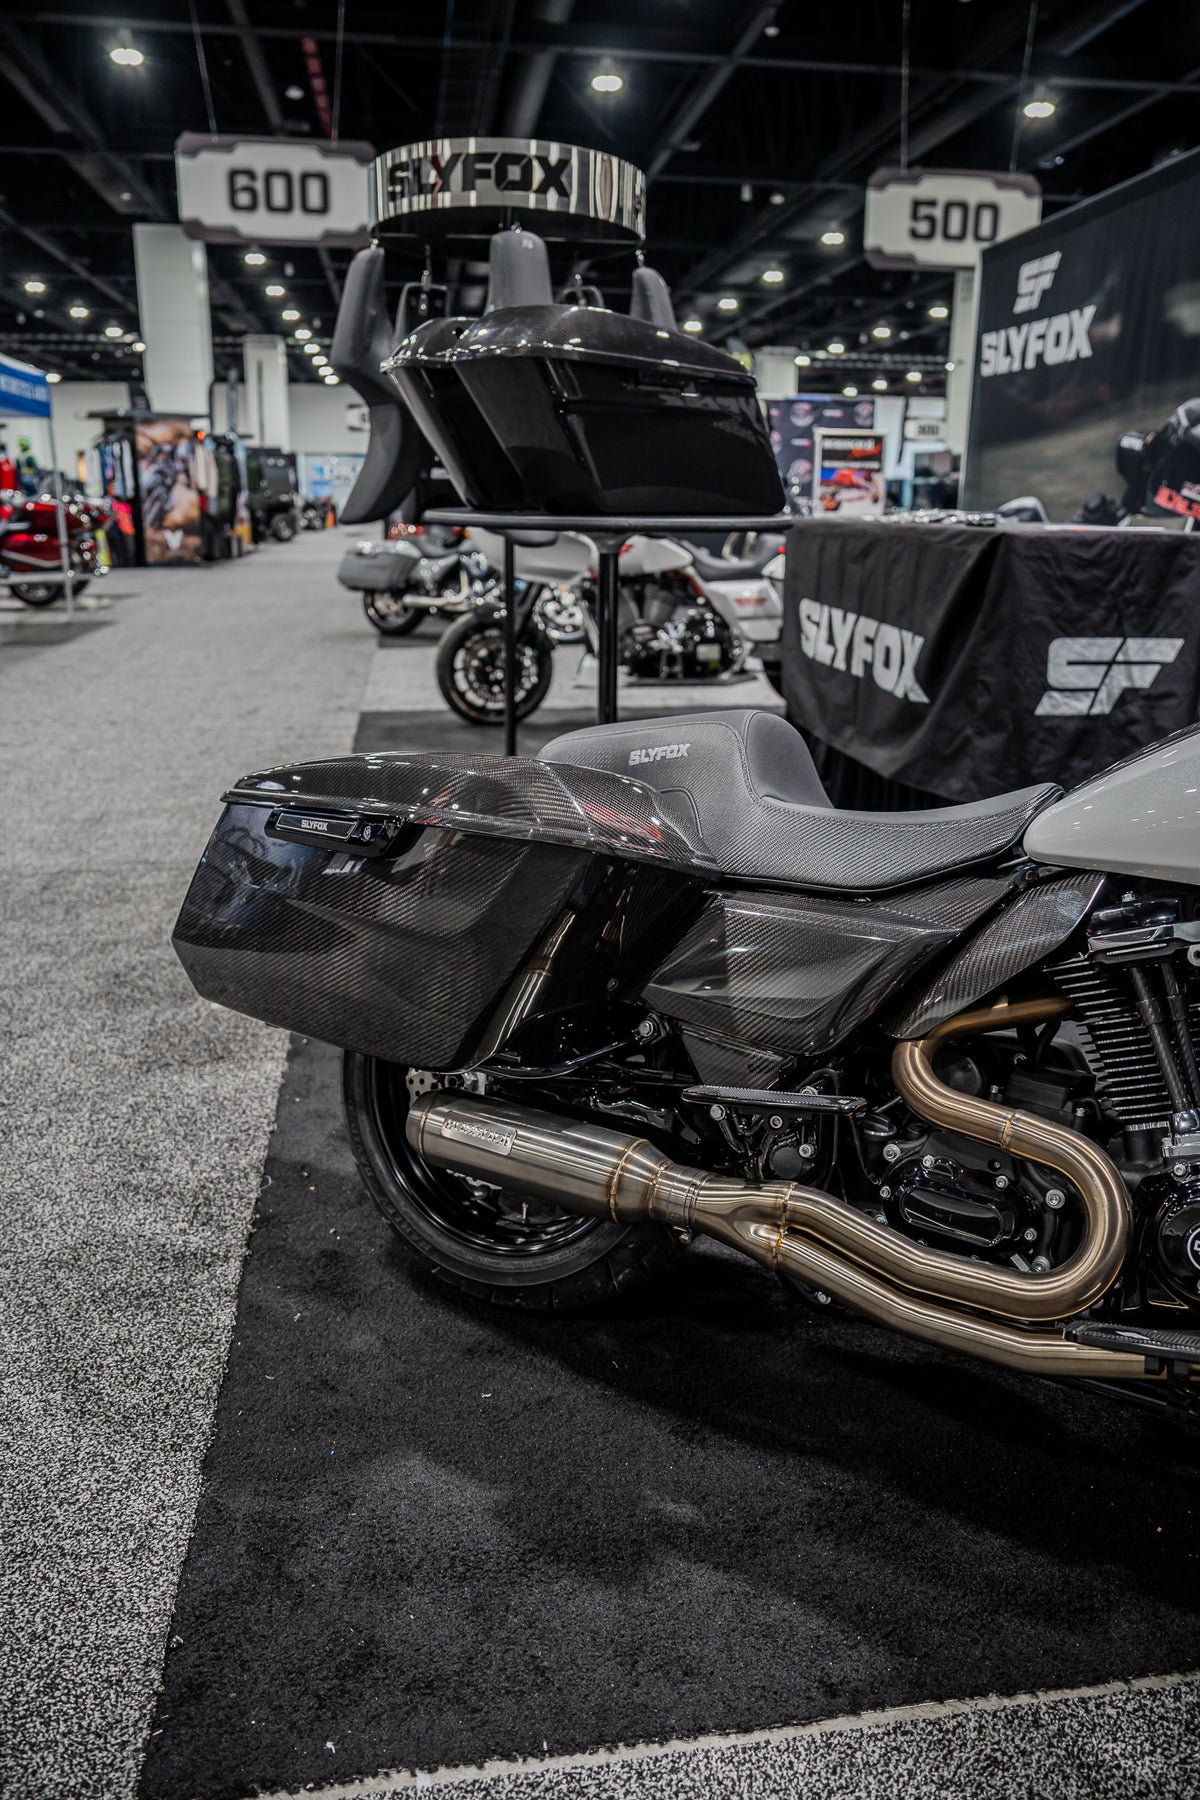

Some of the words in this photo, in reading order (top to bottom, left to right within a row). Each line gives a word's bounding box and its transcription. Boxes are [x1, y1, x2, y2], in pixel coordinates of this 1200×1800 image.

[228, 168, 330, 214] 600
[389, 152, 572, 201] SLYFOX
[908, 197, 1000, 243] 500
[980, 304, 1098, 378] SLYFOX
[798, 597, 930, 705] SLYFOX
[628, 743, 691, 766] SLYFOX
[300, 819, 328, 832] SLYFOX
